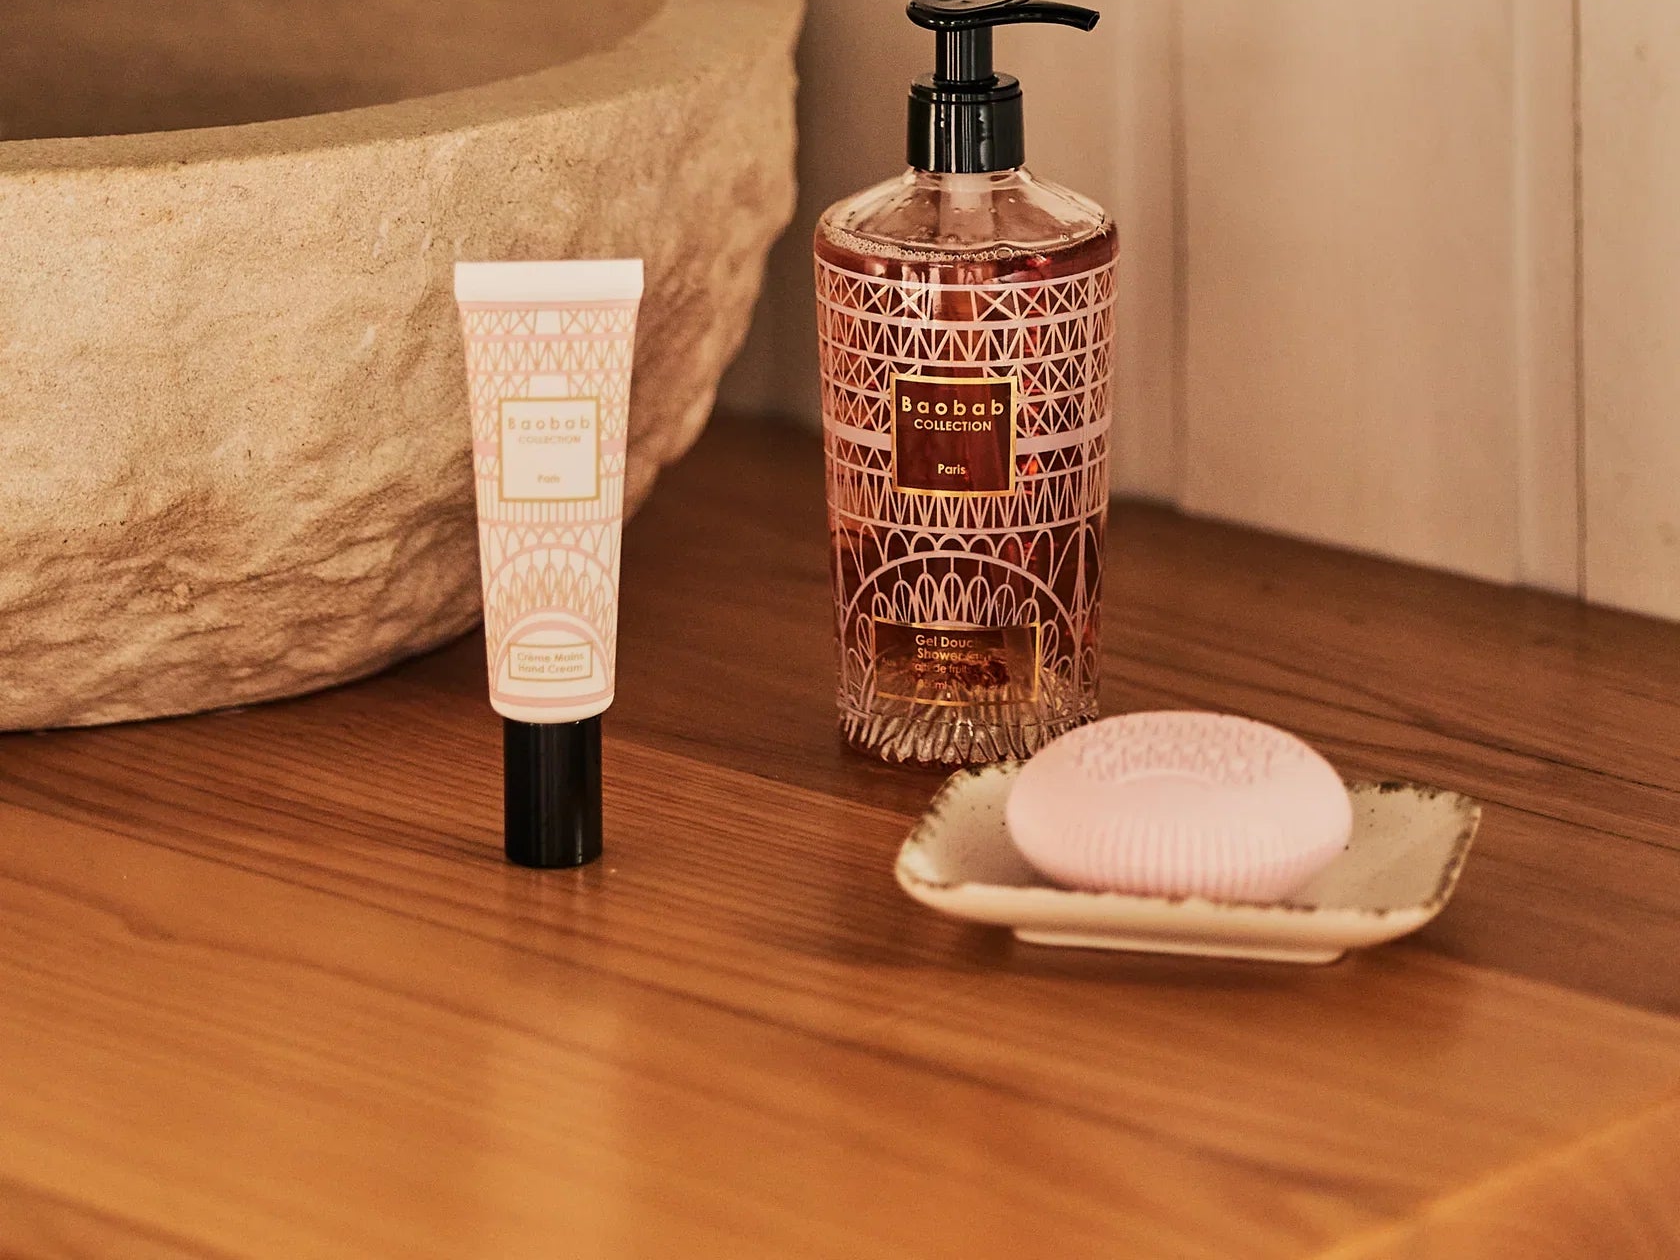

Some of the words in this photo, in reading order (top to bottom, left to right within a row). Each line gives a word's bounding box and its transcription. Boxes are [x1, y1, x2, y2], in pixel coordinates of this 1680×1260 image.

[901, 395, 1004, 416] Baobab
[508, 416, 590, 430] Baobab
[914, 419, 992, 432] COLLECTION
[518, 435, 582, 445] COLLECTION
[937, 463, 967, 475] Paris
[915, 634, 938, 647] Gel
[941, 636, 980, 649] Douc
[917, 647, 966, 661] Shower
